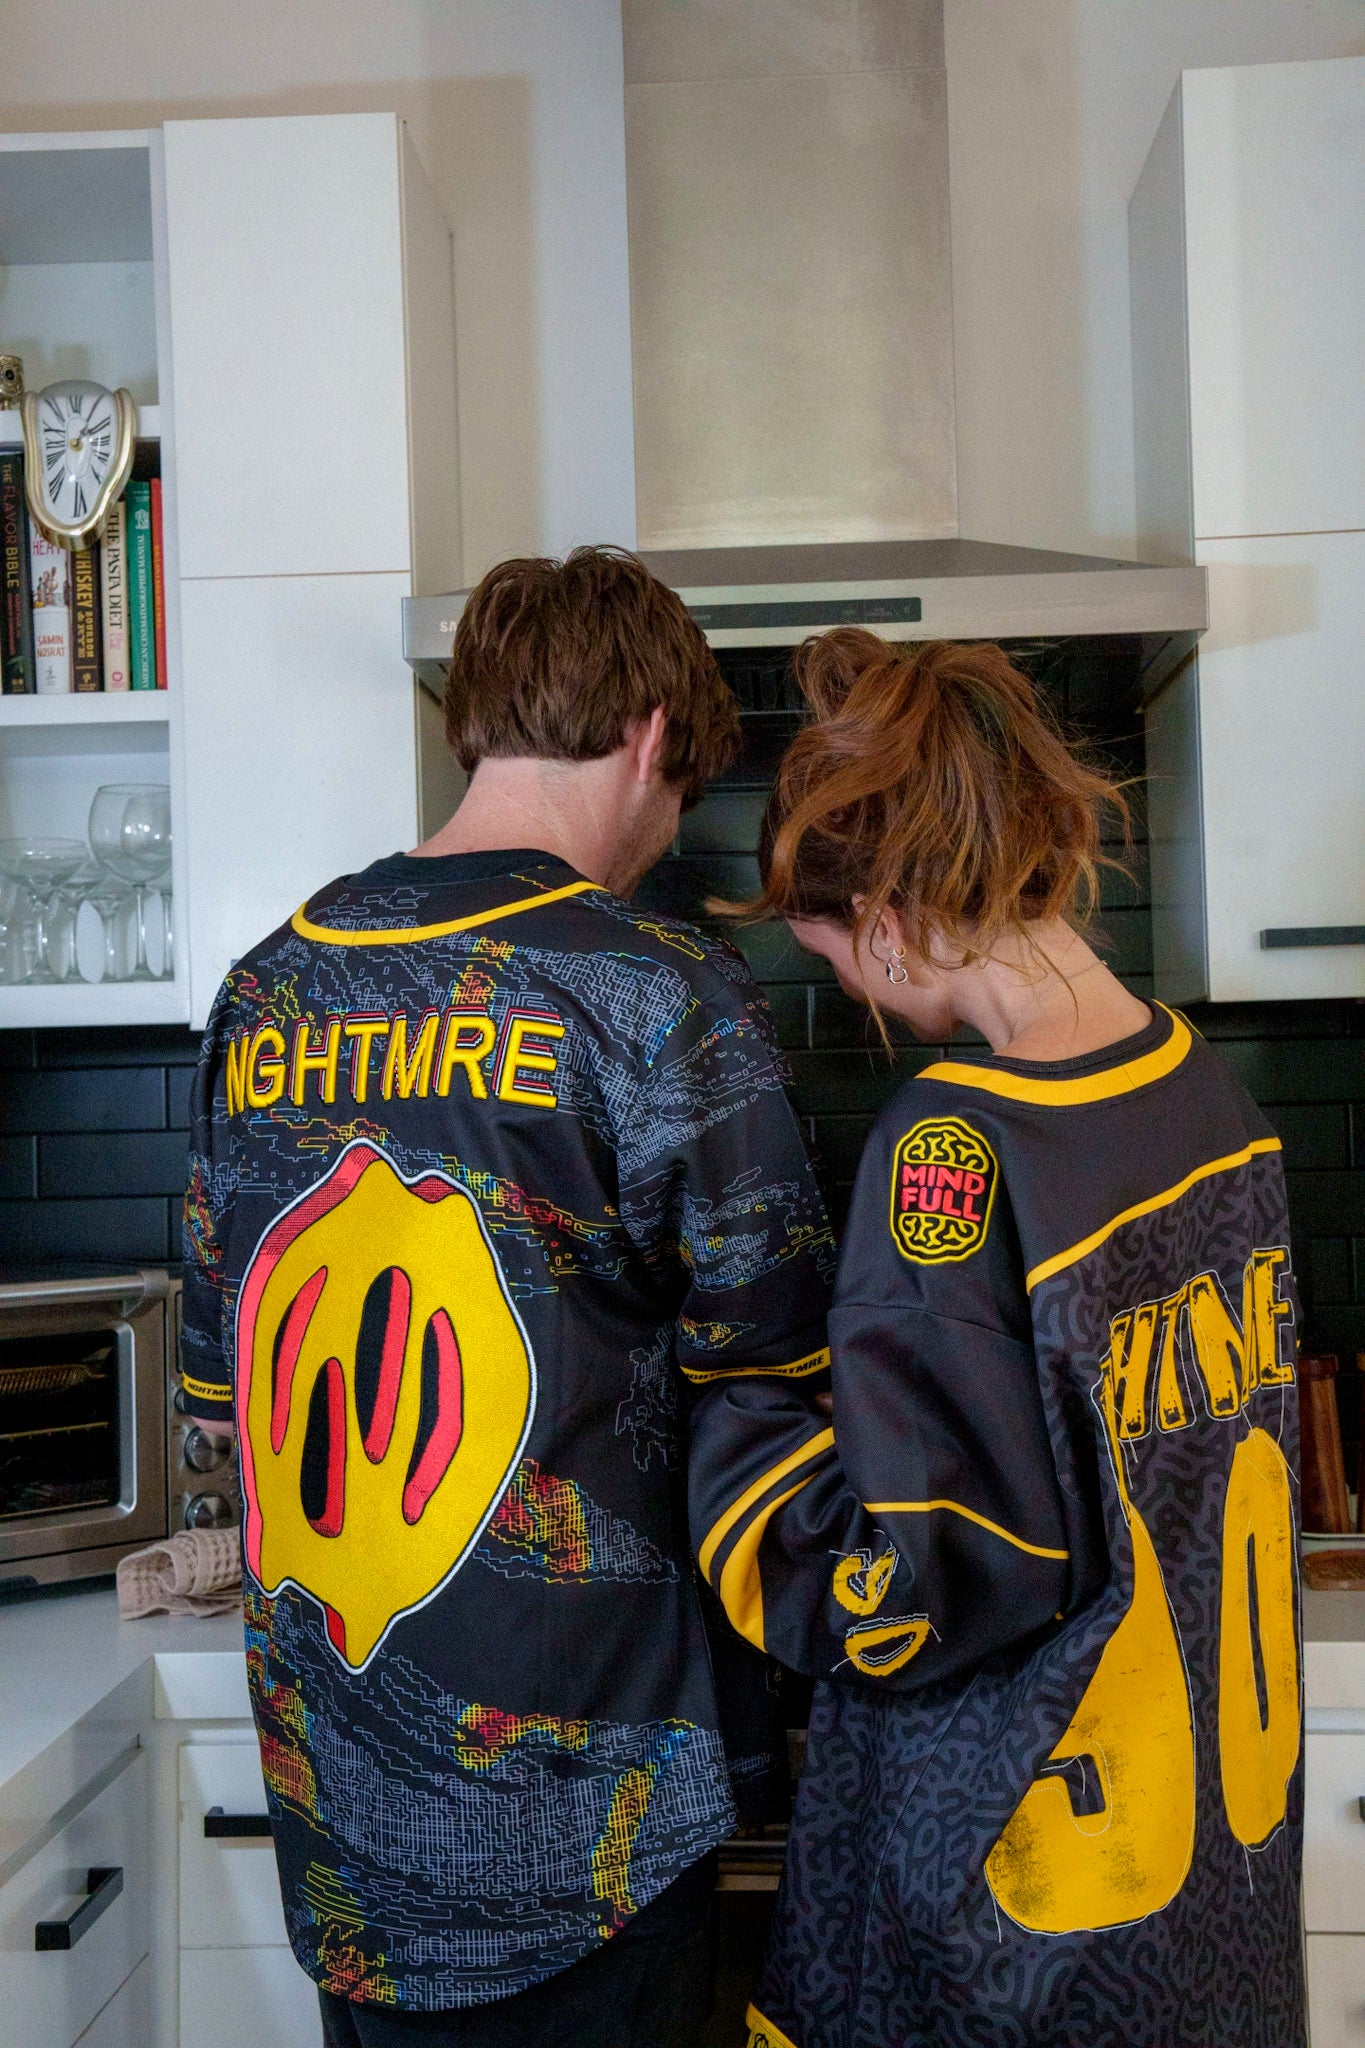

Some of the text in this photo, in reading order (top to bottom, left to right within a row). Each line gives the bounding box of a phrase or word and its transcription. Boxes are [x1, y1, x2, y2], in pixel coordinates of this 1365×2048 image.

[2, 464, 13, 483] THE
[4, 485, 18, 545] FLAVOR
[106, 511, 120, 545] THE
[5, 547, 19, 588] BIBLE
[137, 535, 146, 567] MANUAL
[76, 549, 93, 608] WHISKEY
[107, 548, 121, 590] PASTA
[108, 594, 123, 629] DIET
[38, 633, 64, 647] SAMIN
[84, 611, 95, 658] BOURBON
[226, 1007, 567, 1117] NGHTMRE
[902, 1164, 986, 1195] MIND
[901, 1187, 981, 1221] FULL
